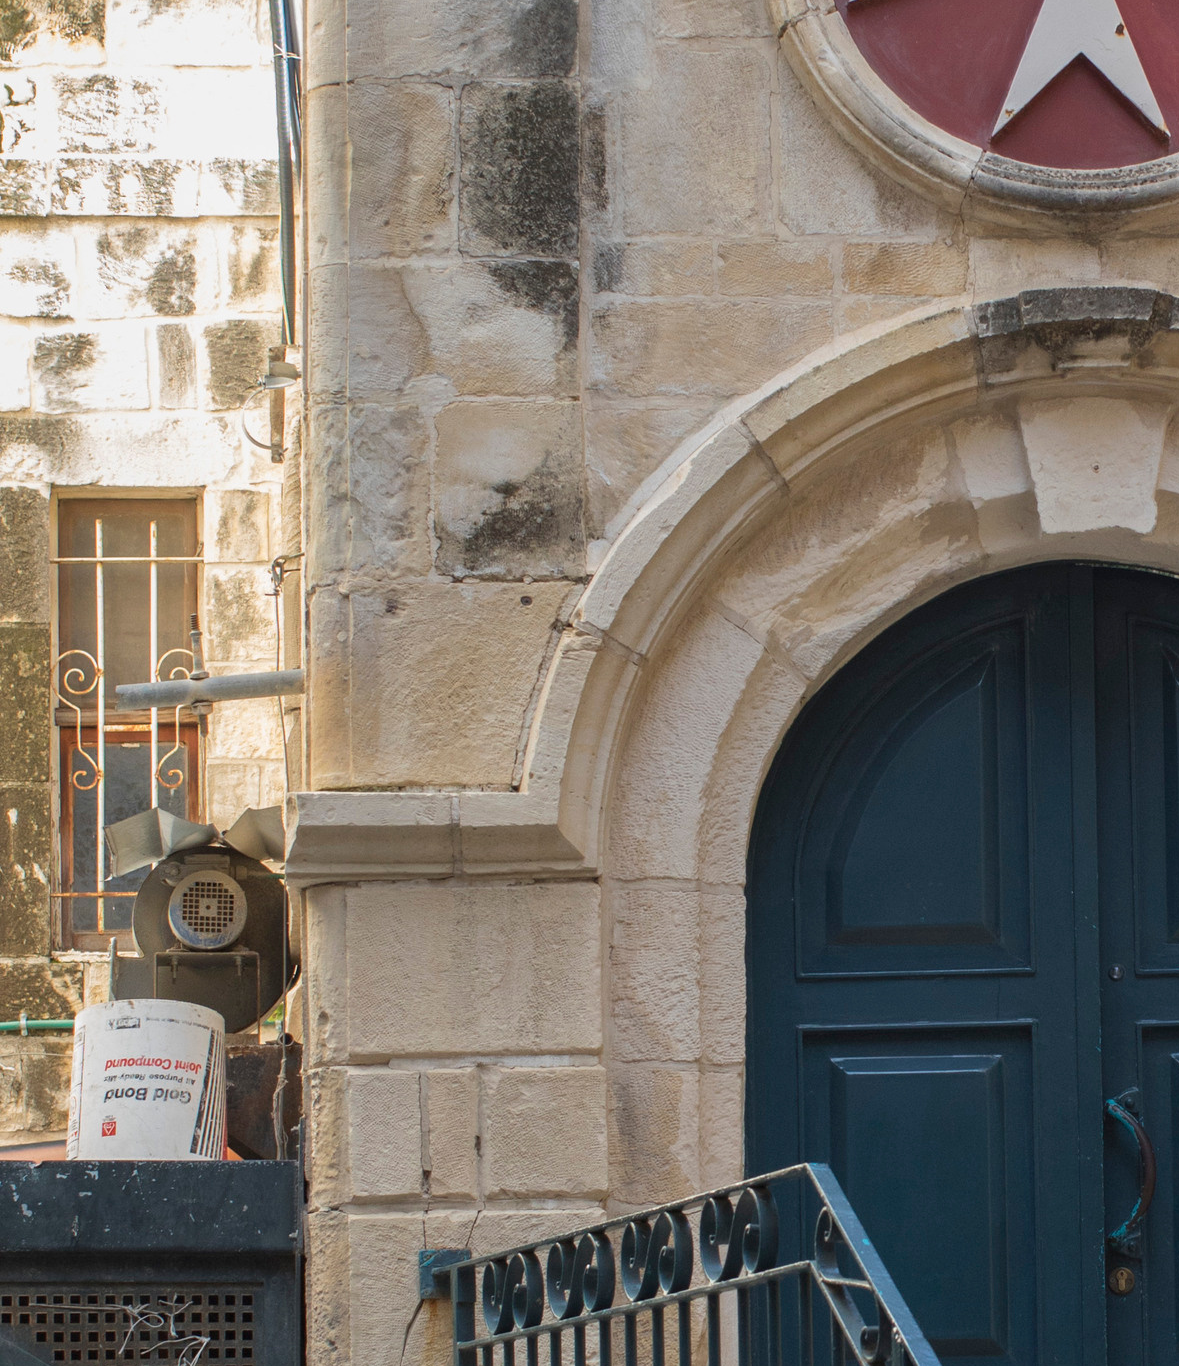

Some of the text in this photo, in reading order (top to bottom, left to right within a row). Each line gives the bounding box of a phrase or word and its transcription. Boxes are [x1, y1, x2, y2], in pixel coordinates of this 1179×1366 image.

[104, 1055, 202, 1074] Joint Compound
[149, 1073, 184, 1083] Purpose
[103, 1087, 192, 1104] Gold Bond
